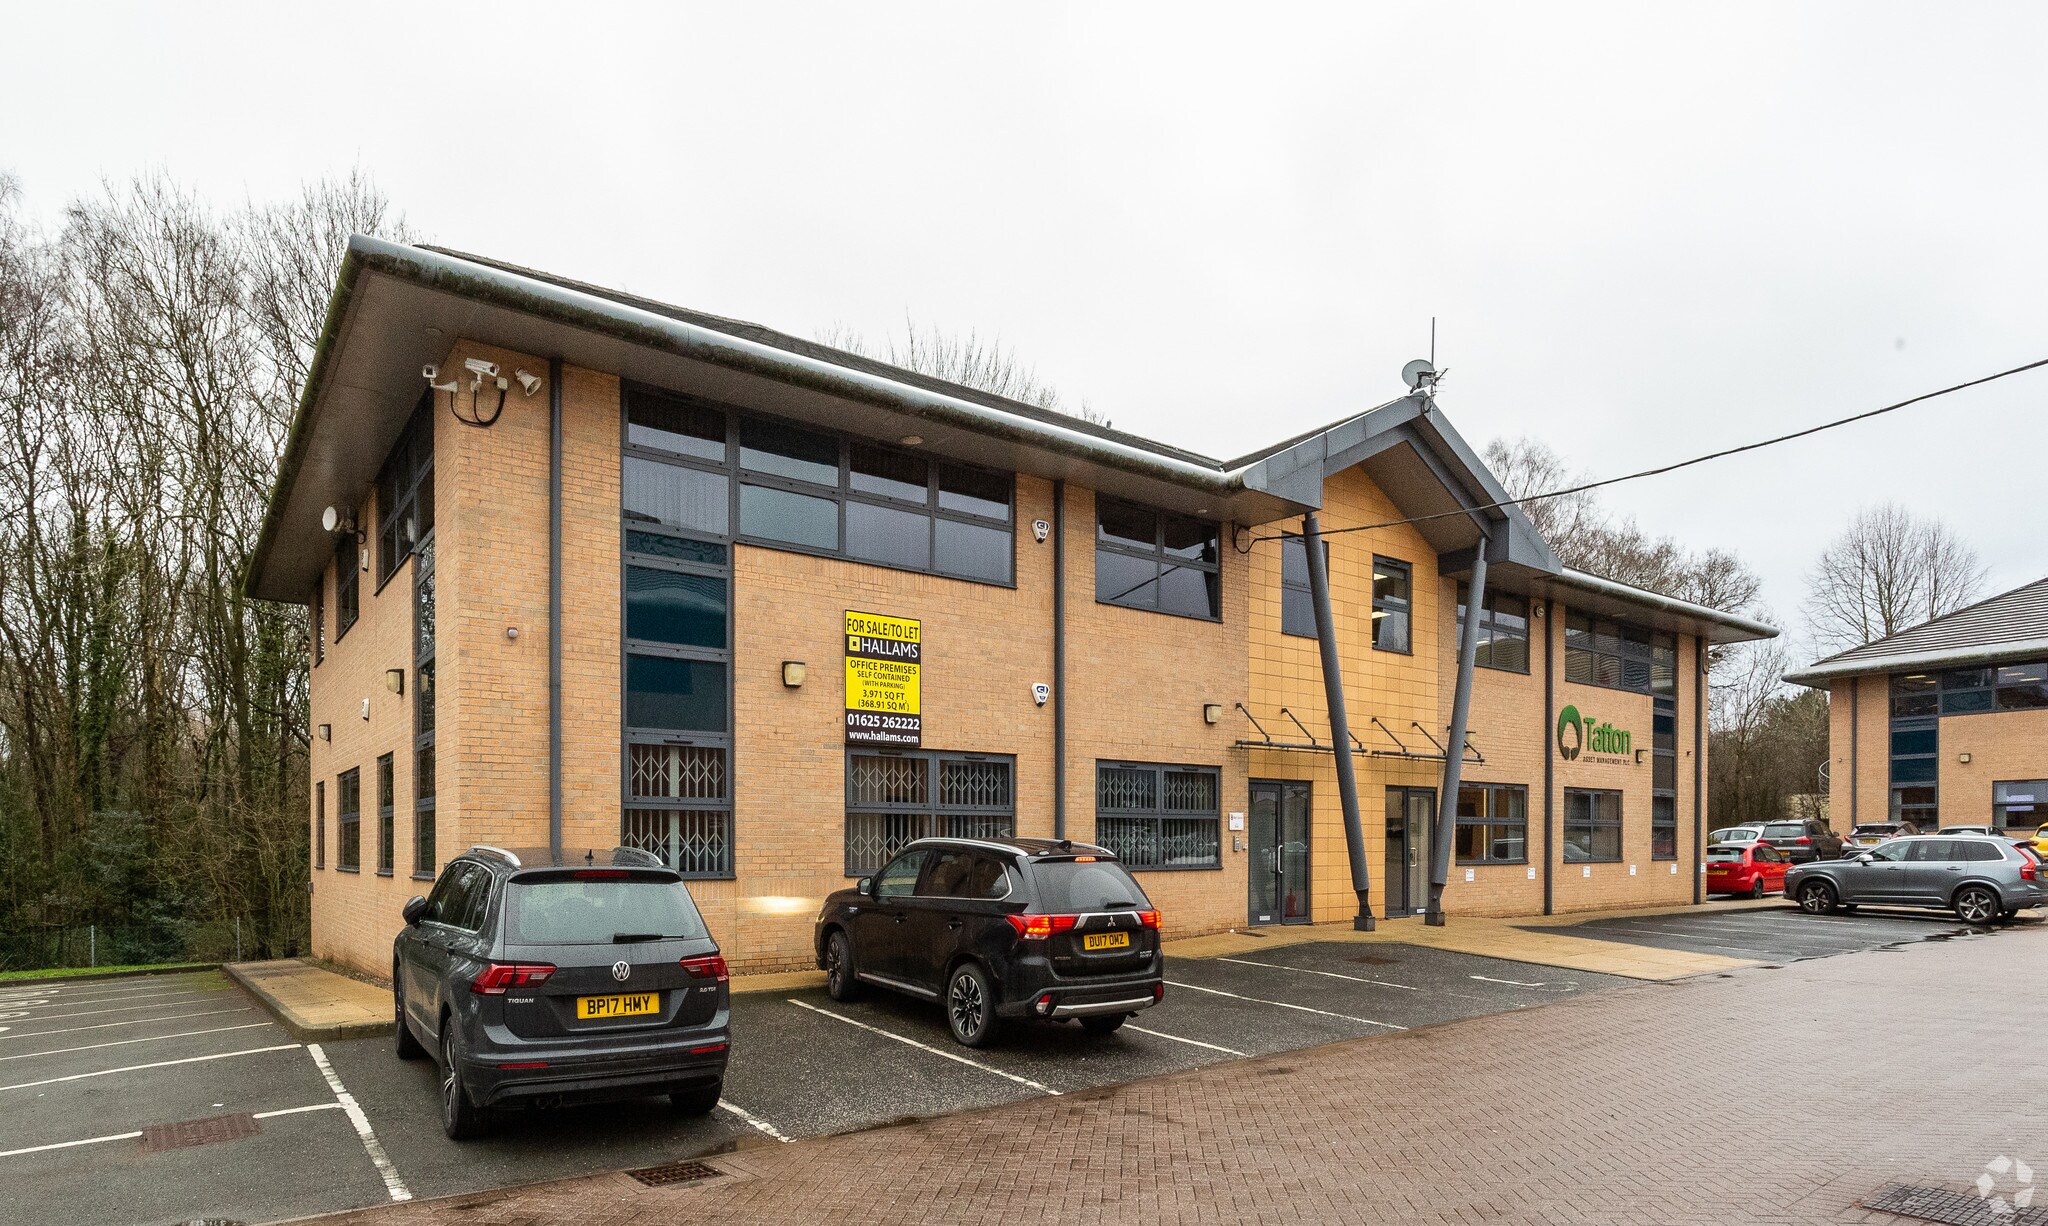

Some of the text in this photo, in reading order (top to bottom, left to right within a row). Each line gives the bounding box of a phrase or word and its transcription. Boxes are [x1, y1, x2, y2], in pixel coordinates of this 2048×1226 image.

[847, 618, 919, 640] FOR SALE/TO LET
[861, 638, 918, 658] HALLAMS
[850, 660, 917, 675] OFFICE PREMISES
[857, 670, 910, 682] SELF CONTAINED
[880, 681, 905, 690] PARKING)
[863, 690, 904, 700] 3,971 SQ FT
[858, 699, 885, 708] (368.91
[887, 701, 897, 710] SQ
[847, 713, 920, 730] 01625 262222
[849, 731, 919, 743] www.hallams.com
[1583, 718, 1631, 754] Tatton
[1089, 935, 1106, 947] DU17
[587, 996, 650, 1015] BP17 HMY
